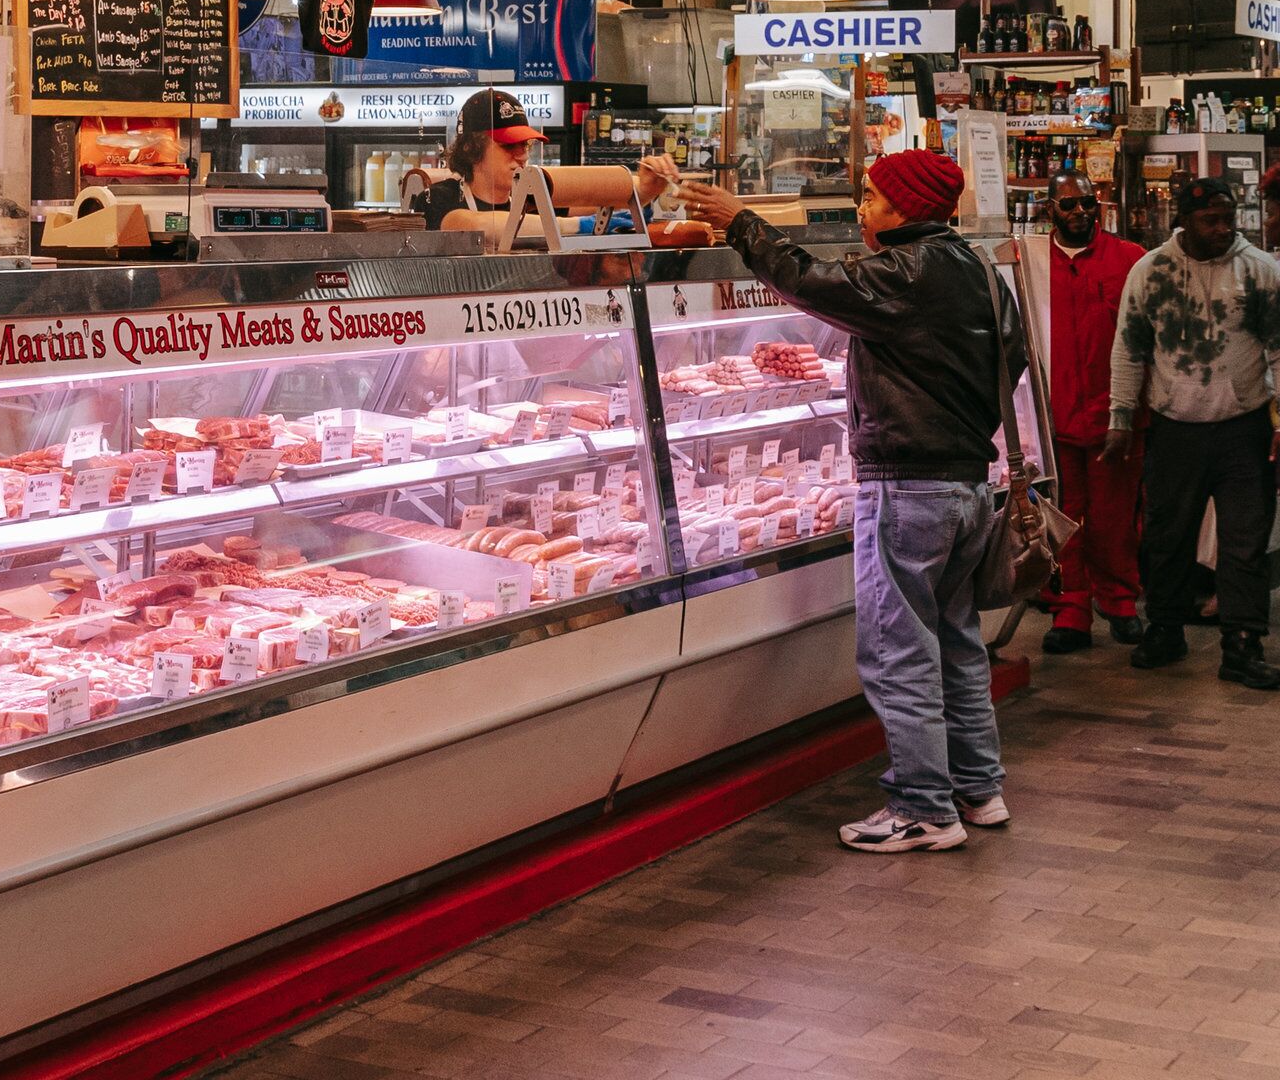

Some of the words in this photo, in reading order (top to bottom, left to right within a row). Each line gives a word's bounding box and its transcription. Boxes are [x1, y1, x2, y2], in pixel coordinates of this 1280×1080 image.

[764, 16, 923, 49] CASHIER
[381, 37, 421, 49] READING
[424, 35, 478, 47] TERMINAL
[523, 69, 554, 78] SALADS
[360, 94, 393, 106] FRESH
[397, 93, 455, 106] SQUEEZED
[518, 93, 551, 105] FRUIT
[772, 89, 816, 101] CASHIER
[243, 96, 305, 108] KOMBUCHA
[245, 109, 303, 120] PROBIOTIC
[357, 107, 420, 120] LEMONADE
[1006, 120, 1022, 128] HOT
[1022, 119, 1048, 128] SAUCE
[113, 314, 212, 365] Quality
[220, 308, 295, 350] Meats
[300, 306, 324, 342] &
[330, 304, 426, 346] Sausages
[461, 297, 583, 334] 215.629.1193
